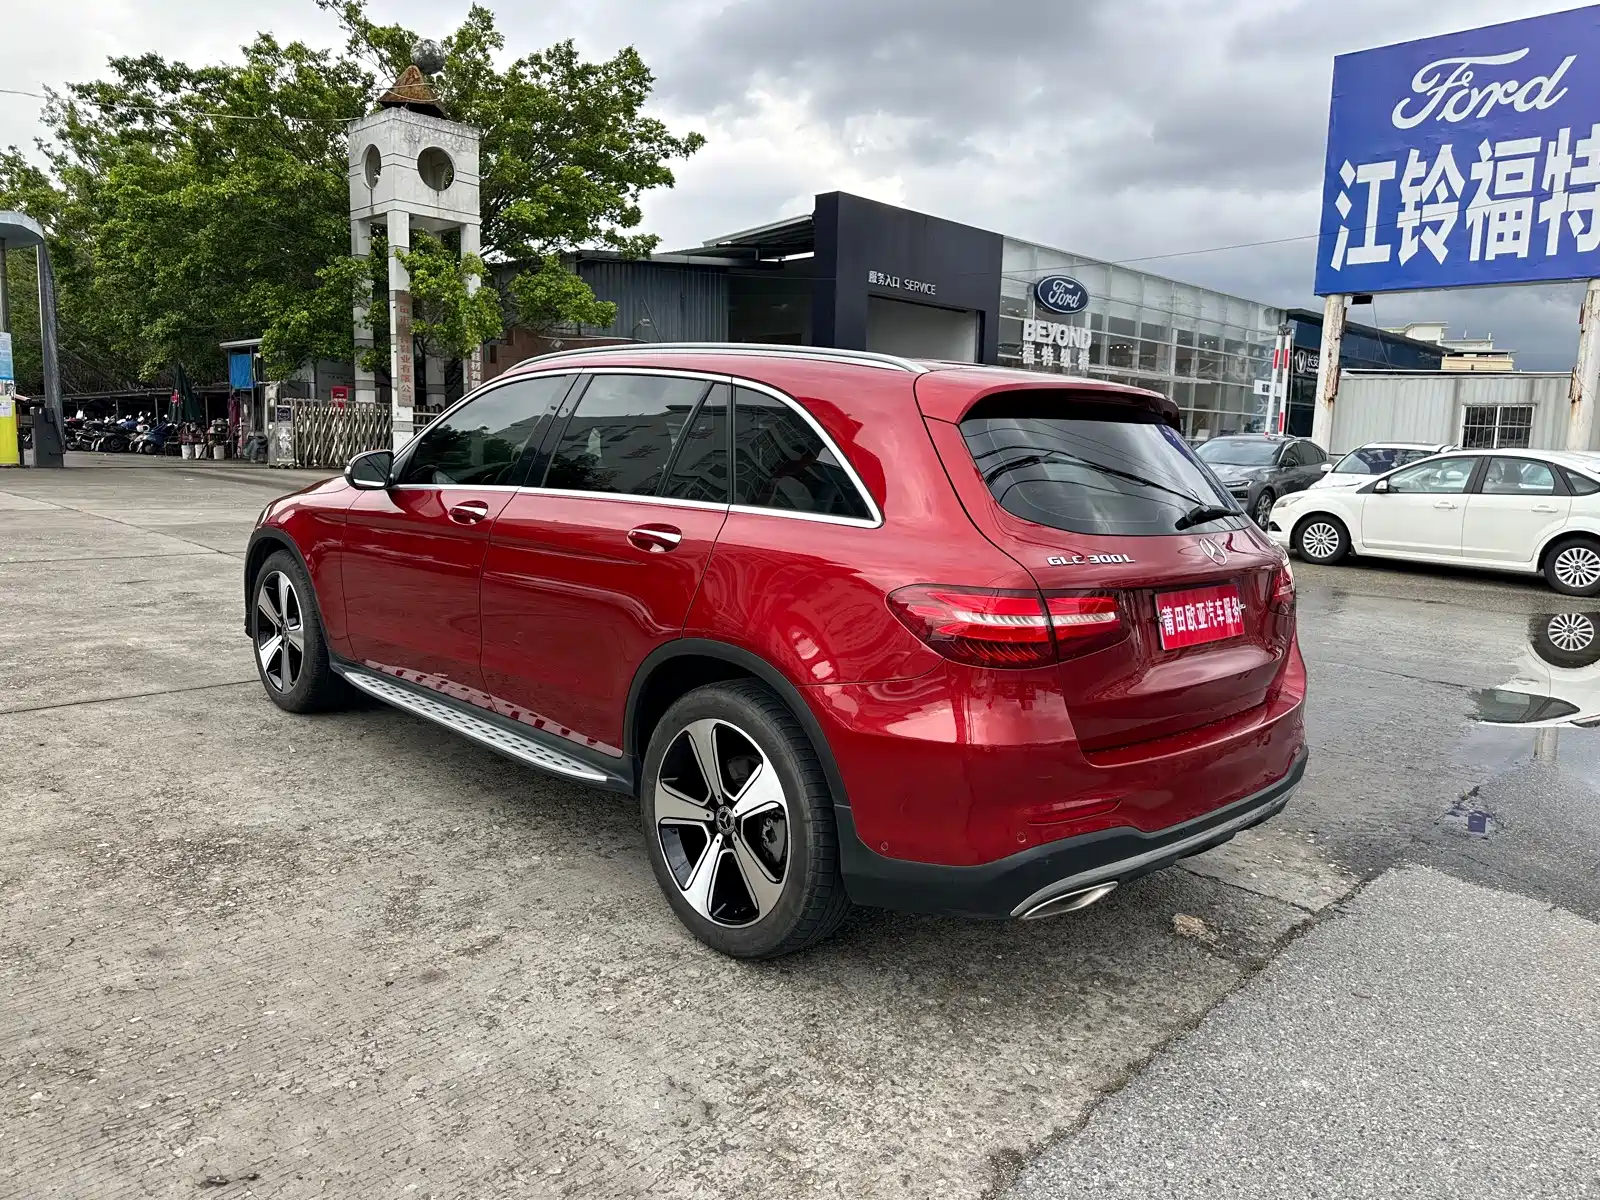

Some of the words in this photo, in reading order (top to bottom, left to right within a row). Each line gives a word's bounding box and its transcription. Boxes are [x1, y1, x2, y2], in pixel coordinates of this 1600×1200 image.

[1392, 47, 1577, 129] Ford
[1330, 123, 1600, 271] 江铃福特
[868, 270, 900, 288] 服务入口
[904, 278, 936, 295] SERVICE
[1048, 280, 1081, 308] Ford
[1023, 319, 1092, 349] BEYOND
[1046, 556, 1085, 566] GLC
[1161, 596, 1242, 637] 莆田欧亚汽车服务
